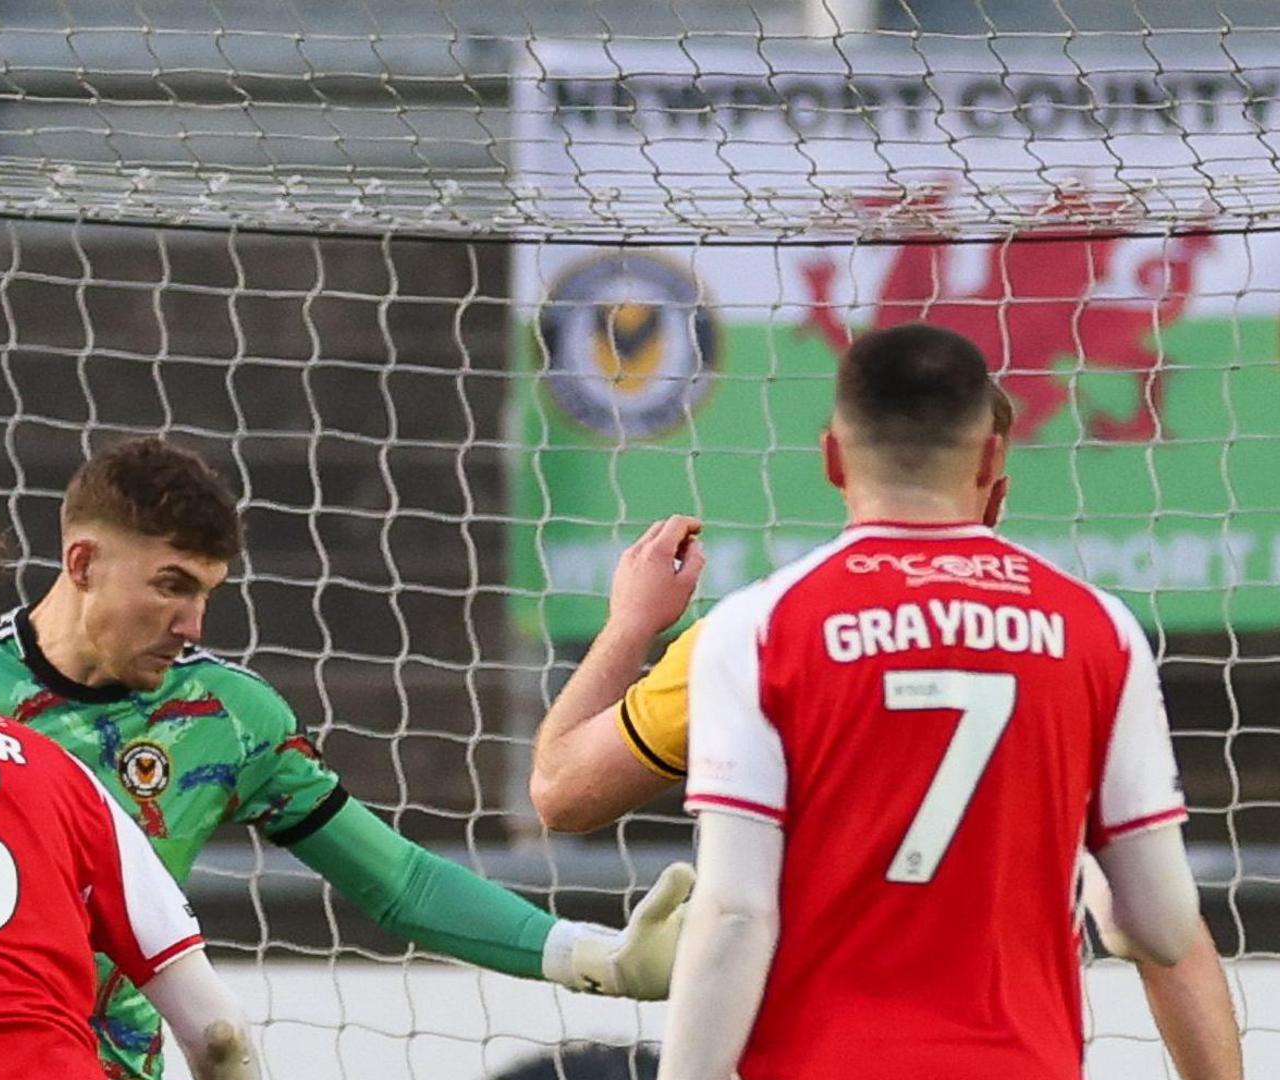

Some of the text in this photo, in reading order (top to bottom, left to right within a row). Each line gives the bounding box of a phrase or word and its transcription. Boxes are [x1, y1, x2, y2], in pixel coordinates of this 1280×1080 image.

[551, 78, 930, 133] NEWPORT
[958, 76, 1280, 133] COUNTY
[823, 598, 1065, 663] GRAYDON
[883, 668, 1017, 884] 7
